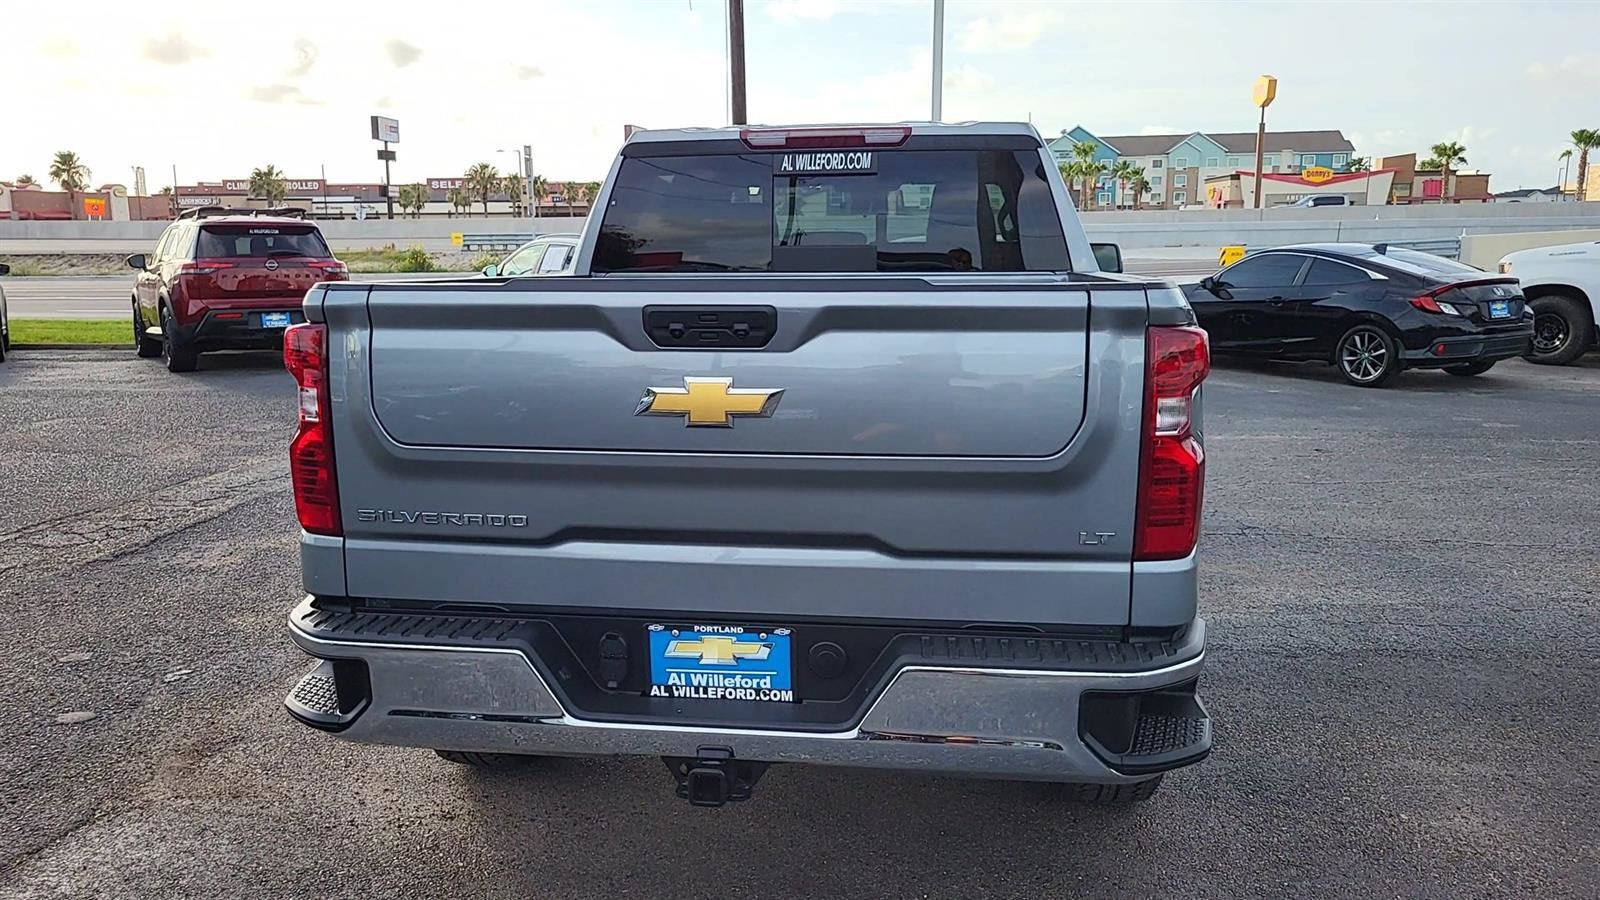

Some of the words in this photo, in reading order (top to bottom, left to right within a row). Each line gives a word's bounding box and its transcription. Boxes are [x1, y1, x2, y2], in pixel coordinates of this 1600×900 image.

[781, 154, 793, 171] AL
[796, 152, 871, 171] WILLEFORD.COM
[1306, 170, 1330, 179] Denny's
[431, 180, 463, 189] SELF
[358, 509, 528, 527] SILVERADO
[1079, 531, 1116, 545] LT
[693, 625, 744, 634] PORTLAND
[667, 672, 686, 686] Al
[690, 672, 771, 689] Willeford
[650, 685, 669, 697] AL
[672, 686, 793, 702] WILLEFORD.COM
